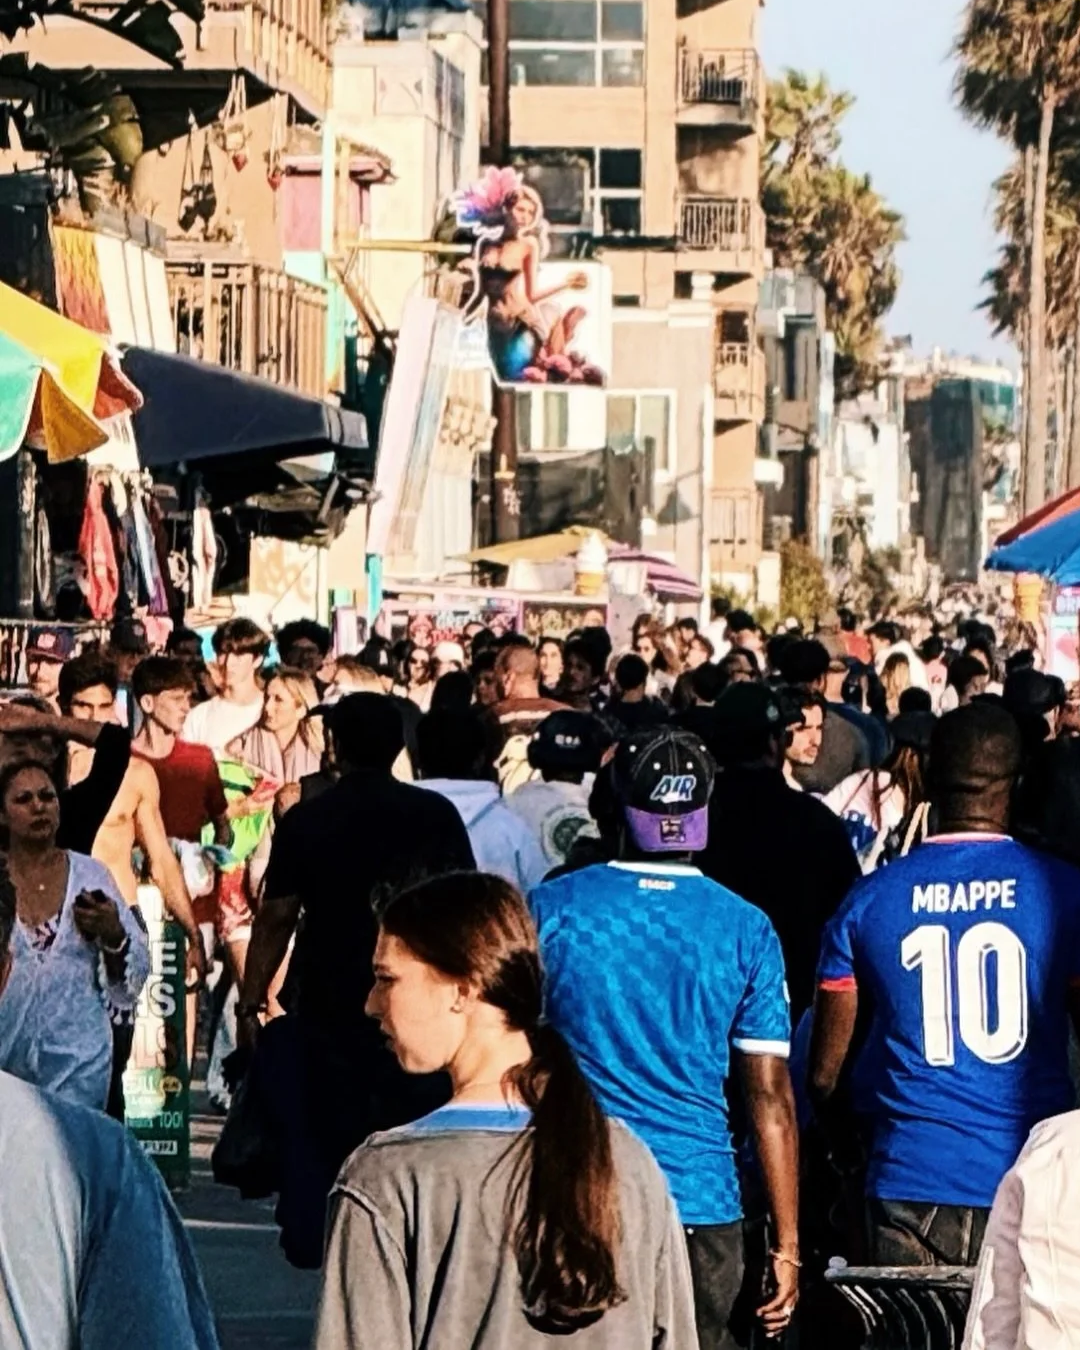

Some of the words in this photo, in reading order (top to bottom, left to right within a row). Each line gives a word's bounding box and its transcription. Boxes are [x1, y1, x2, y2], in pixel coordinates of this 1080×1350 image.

[650, 774, 697, 802] AIR
[912, 879, 1016, 913] MBAPPE
[901, 921, 1028, 1067] 10
